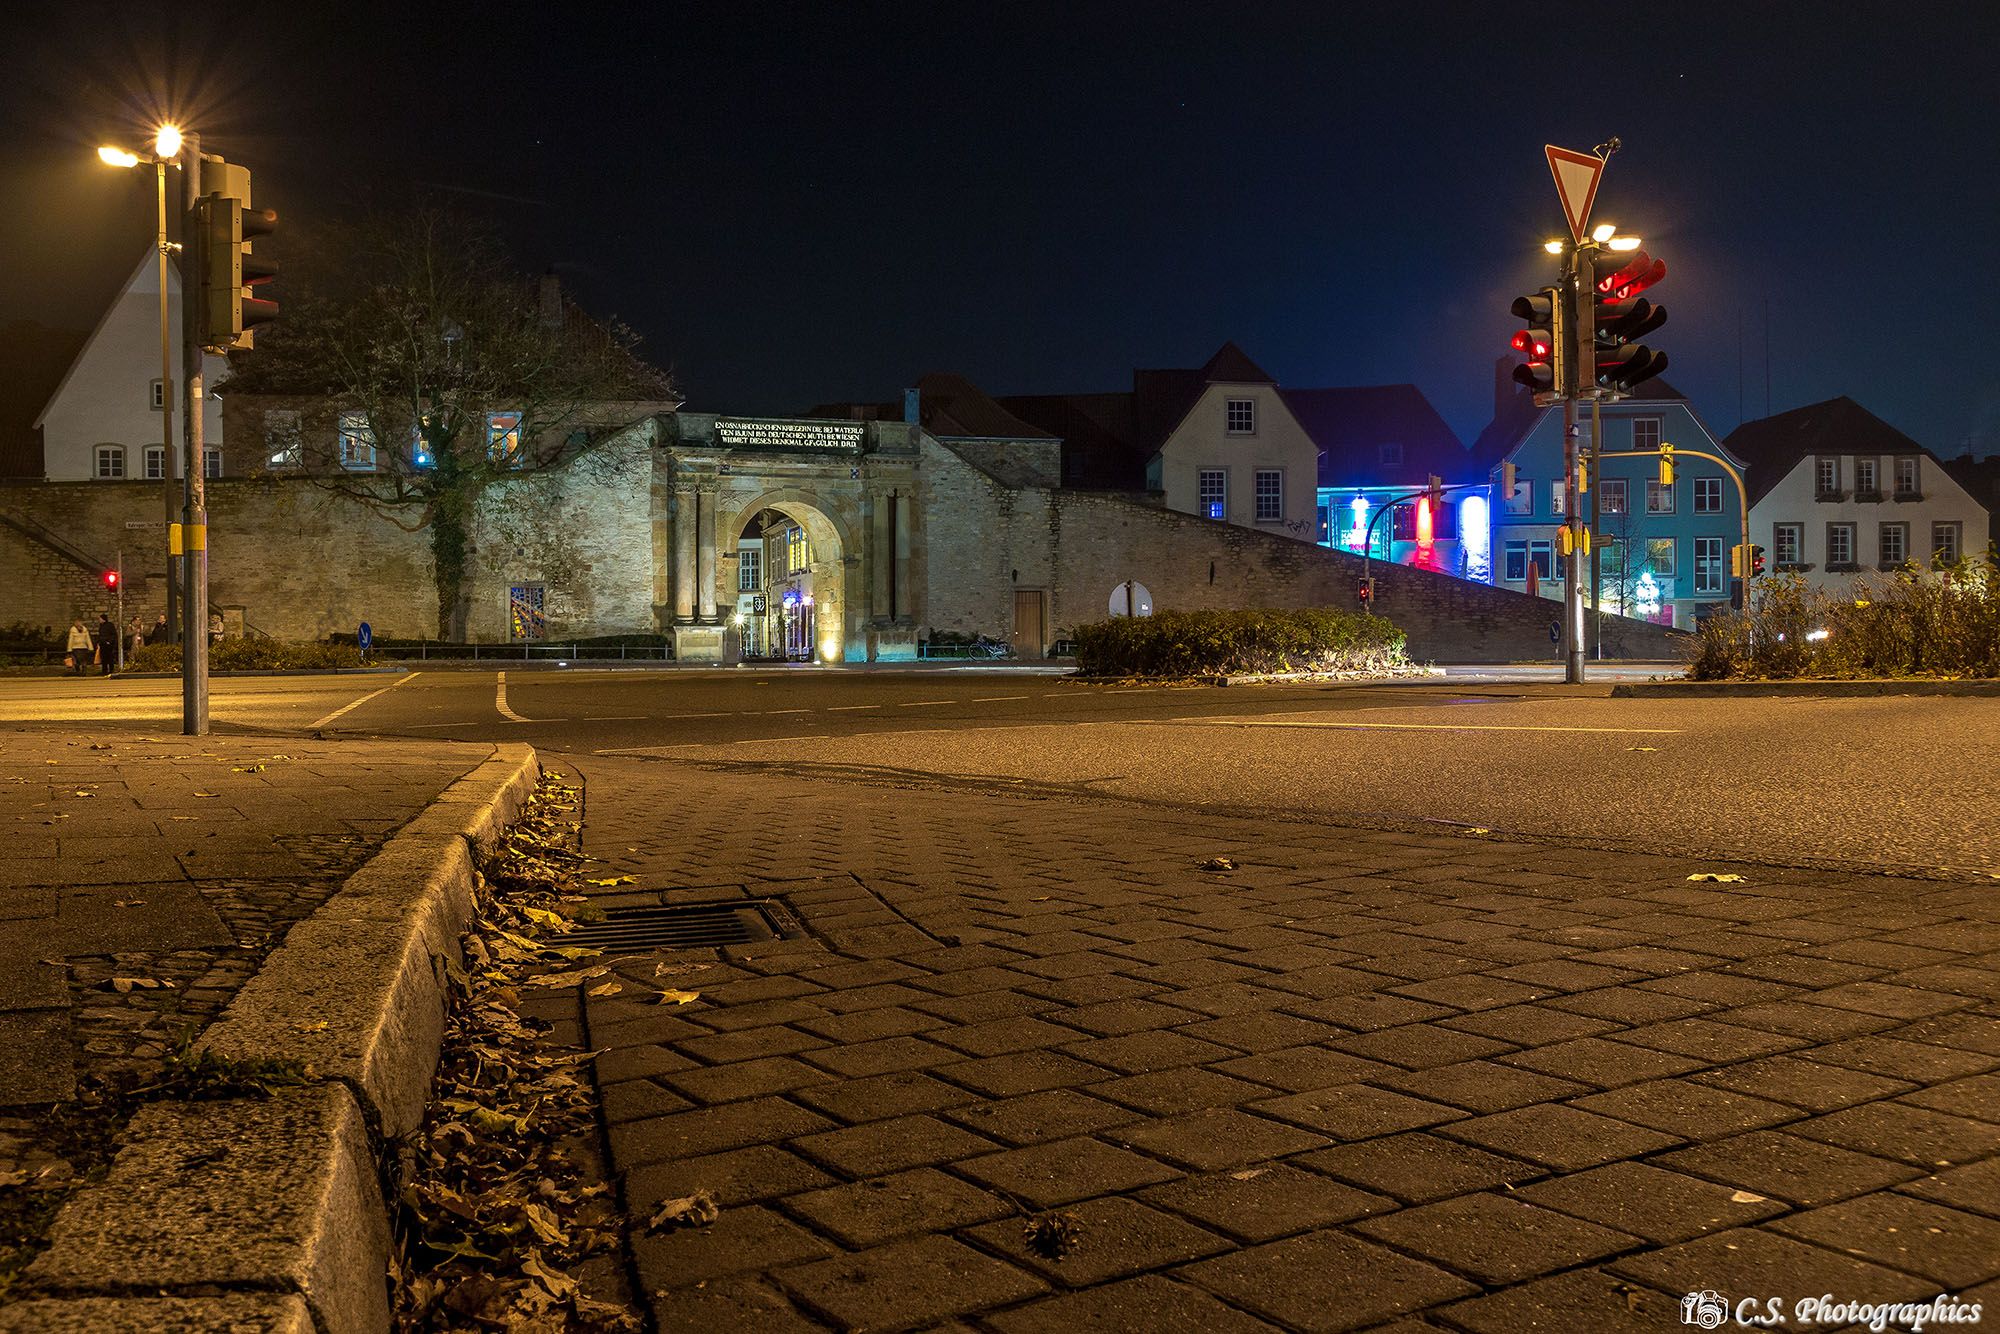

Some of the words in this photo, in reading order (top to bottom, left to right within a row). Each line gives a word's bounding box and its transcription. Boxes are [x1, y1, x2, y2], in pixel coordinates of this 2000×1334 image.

[812, 425, 823, 433] DIE
[768, 431, 806, 439] DEUTSCHEN
[722, 436, 749, 444] WIDMET
[749, 437, 772, 445] DIESES
[772, 438, 804, 446] DENKMAL
